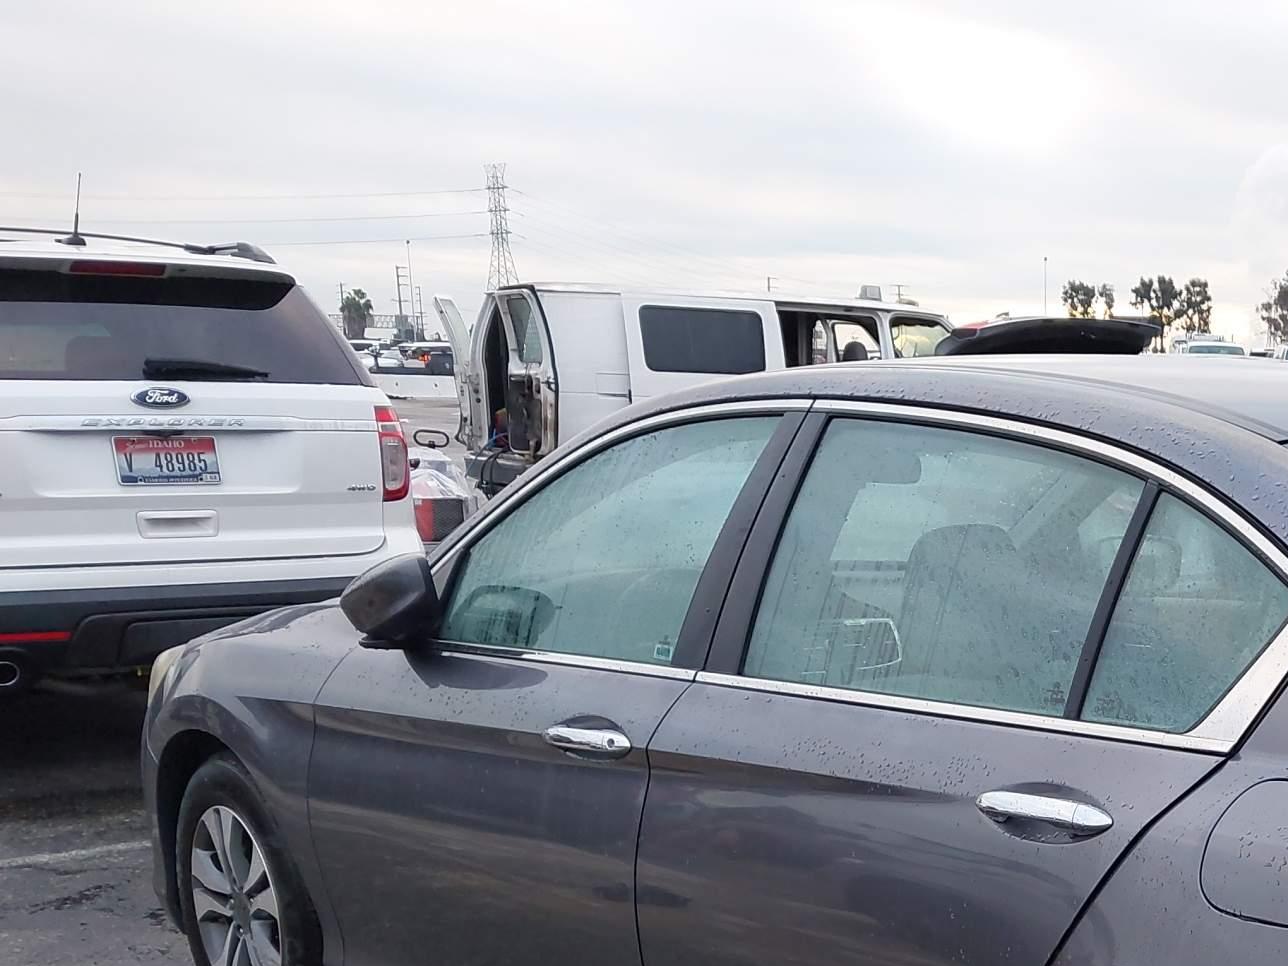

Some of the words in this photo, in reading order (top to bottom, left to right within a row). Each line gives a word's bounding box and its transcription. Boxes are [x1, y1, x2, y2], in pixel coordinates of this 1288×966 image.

[145, 389, 179, 403] Ford
[81, 417, 245, 428] EXPLORER
[148, 439, 185, 449] IDAHO
[123, 452, 134, 473] V
[154, 451, 208, 474] 48985
